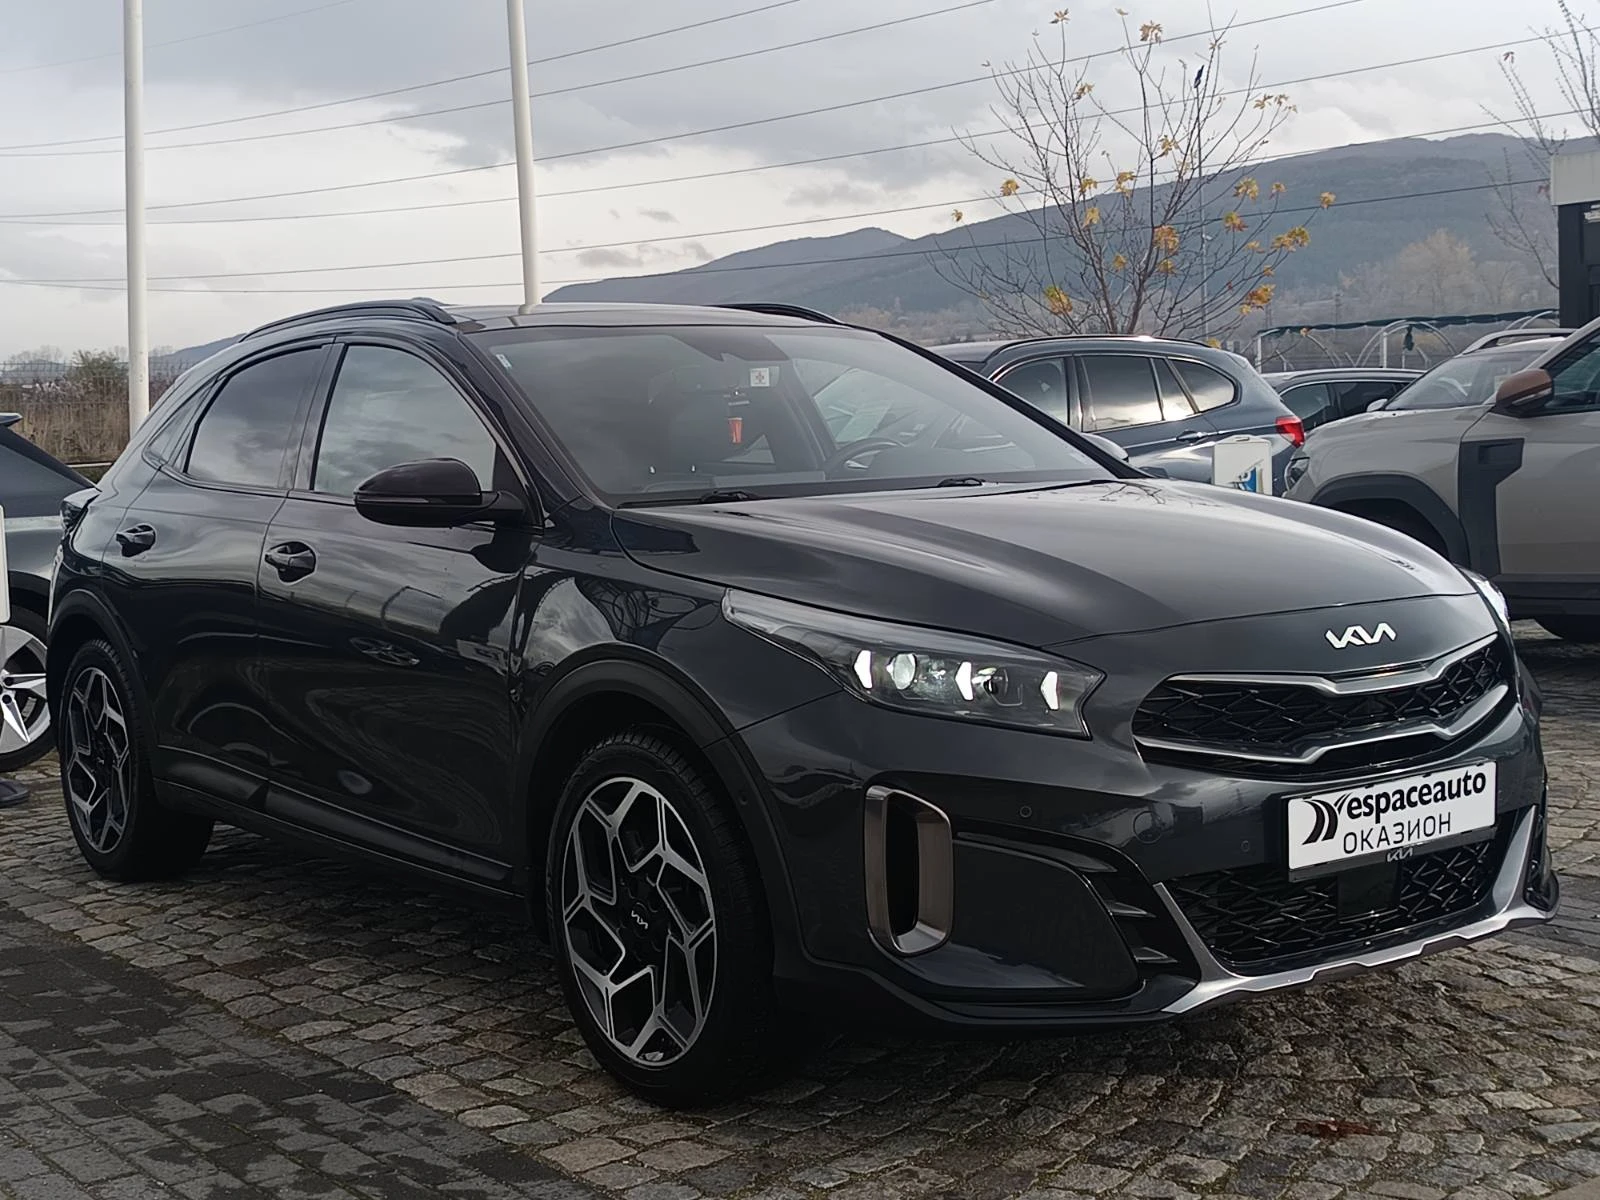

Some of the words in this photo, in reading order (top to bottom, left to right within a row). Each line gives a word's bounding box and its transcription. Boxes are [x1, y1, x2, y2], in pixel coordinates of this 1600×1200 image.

[1325, 622, 1397, 649] KIA
[1346, 770, 1487, 824] espaceauto
[1343, 812, 1451, 854] ОКАЗИОН
[1386, 847, 1414, 863] KIA
